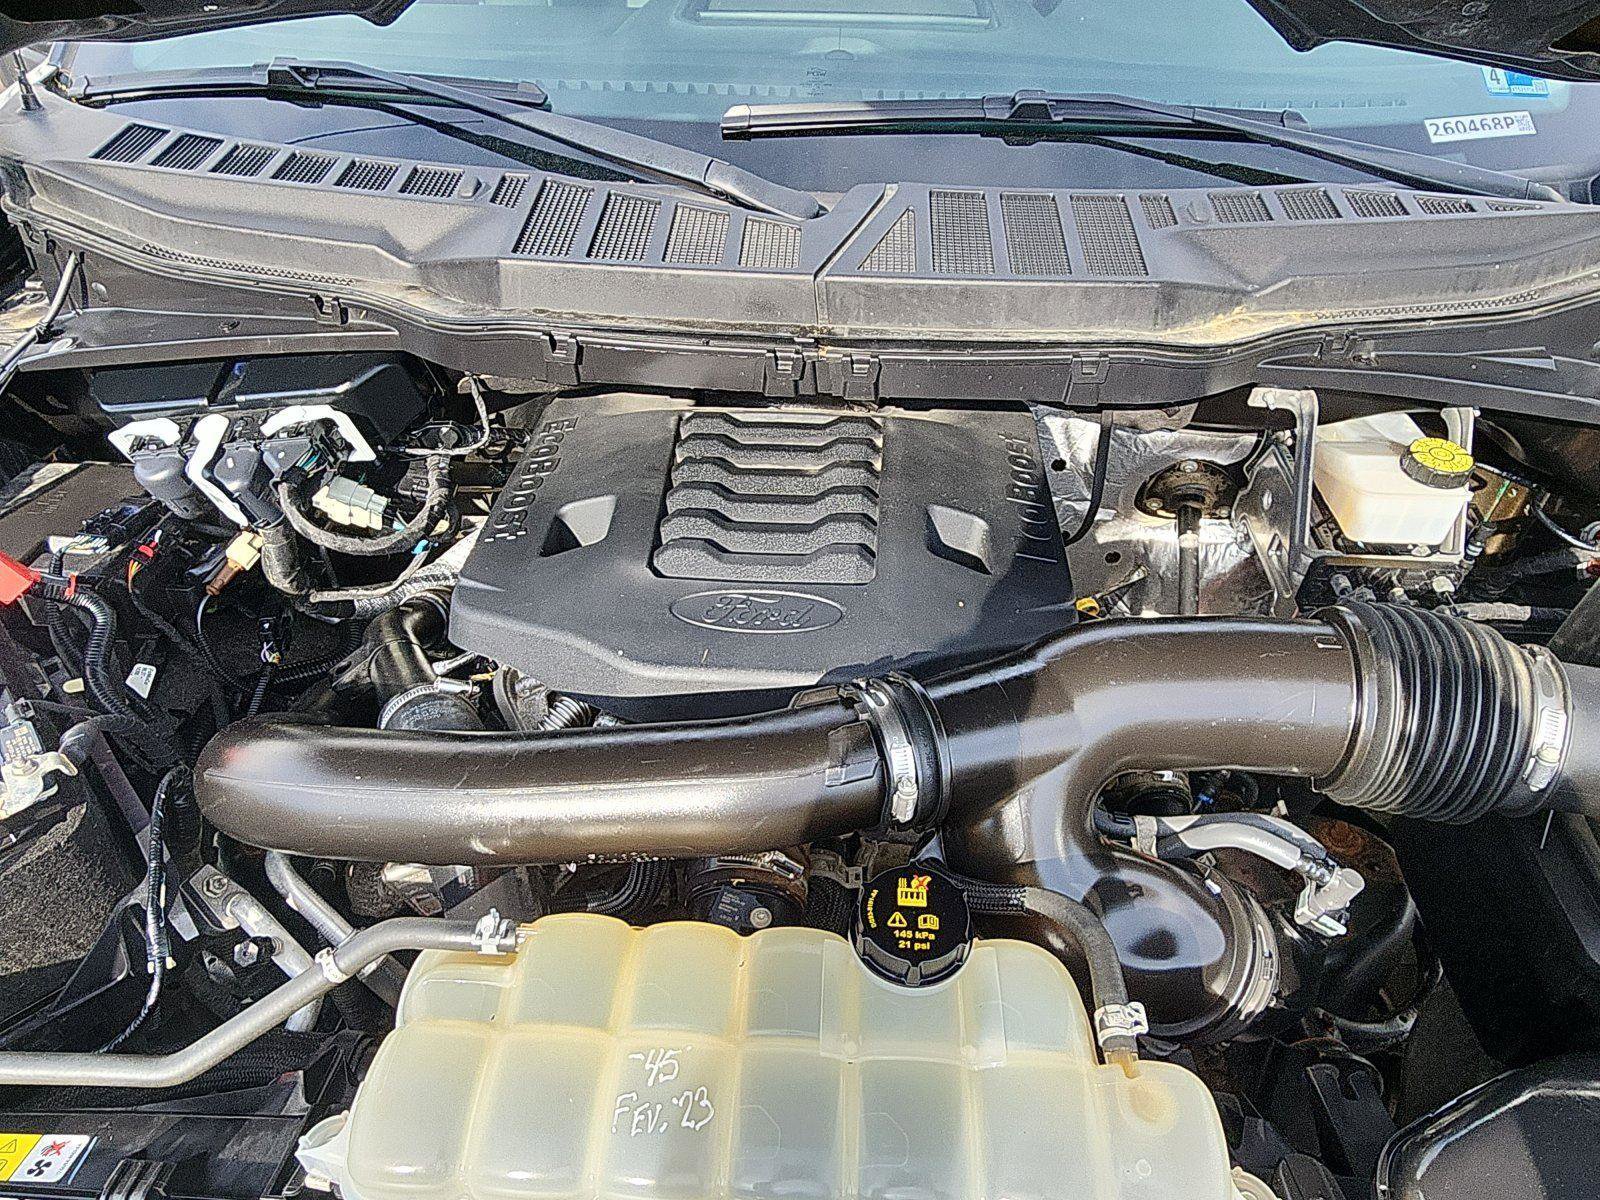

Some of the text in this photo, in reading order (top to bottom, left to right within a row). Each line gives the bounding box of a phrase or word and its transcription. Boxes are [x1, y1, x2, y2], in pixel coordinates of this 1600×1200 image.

[1490, 68, 1501, 85] 4
[1428, 116, 1515, 136] 260468P
[702, 594, 815, 627] Ford
[893, 930, 935, 940] 145 kPa
[898, 940, 931, 951] 21 psi
